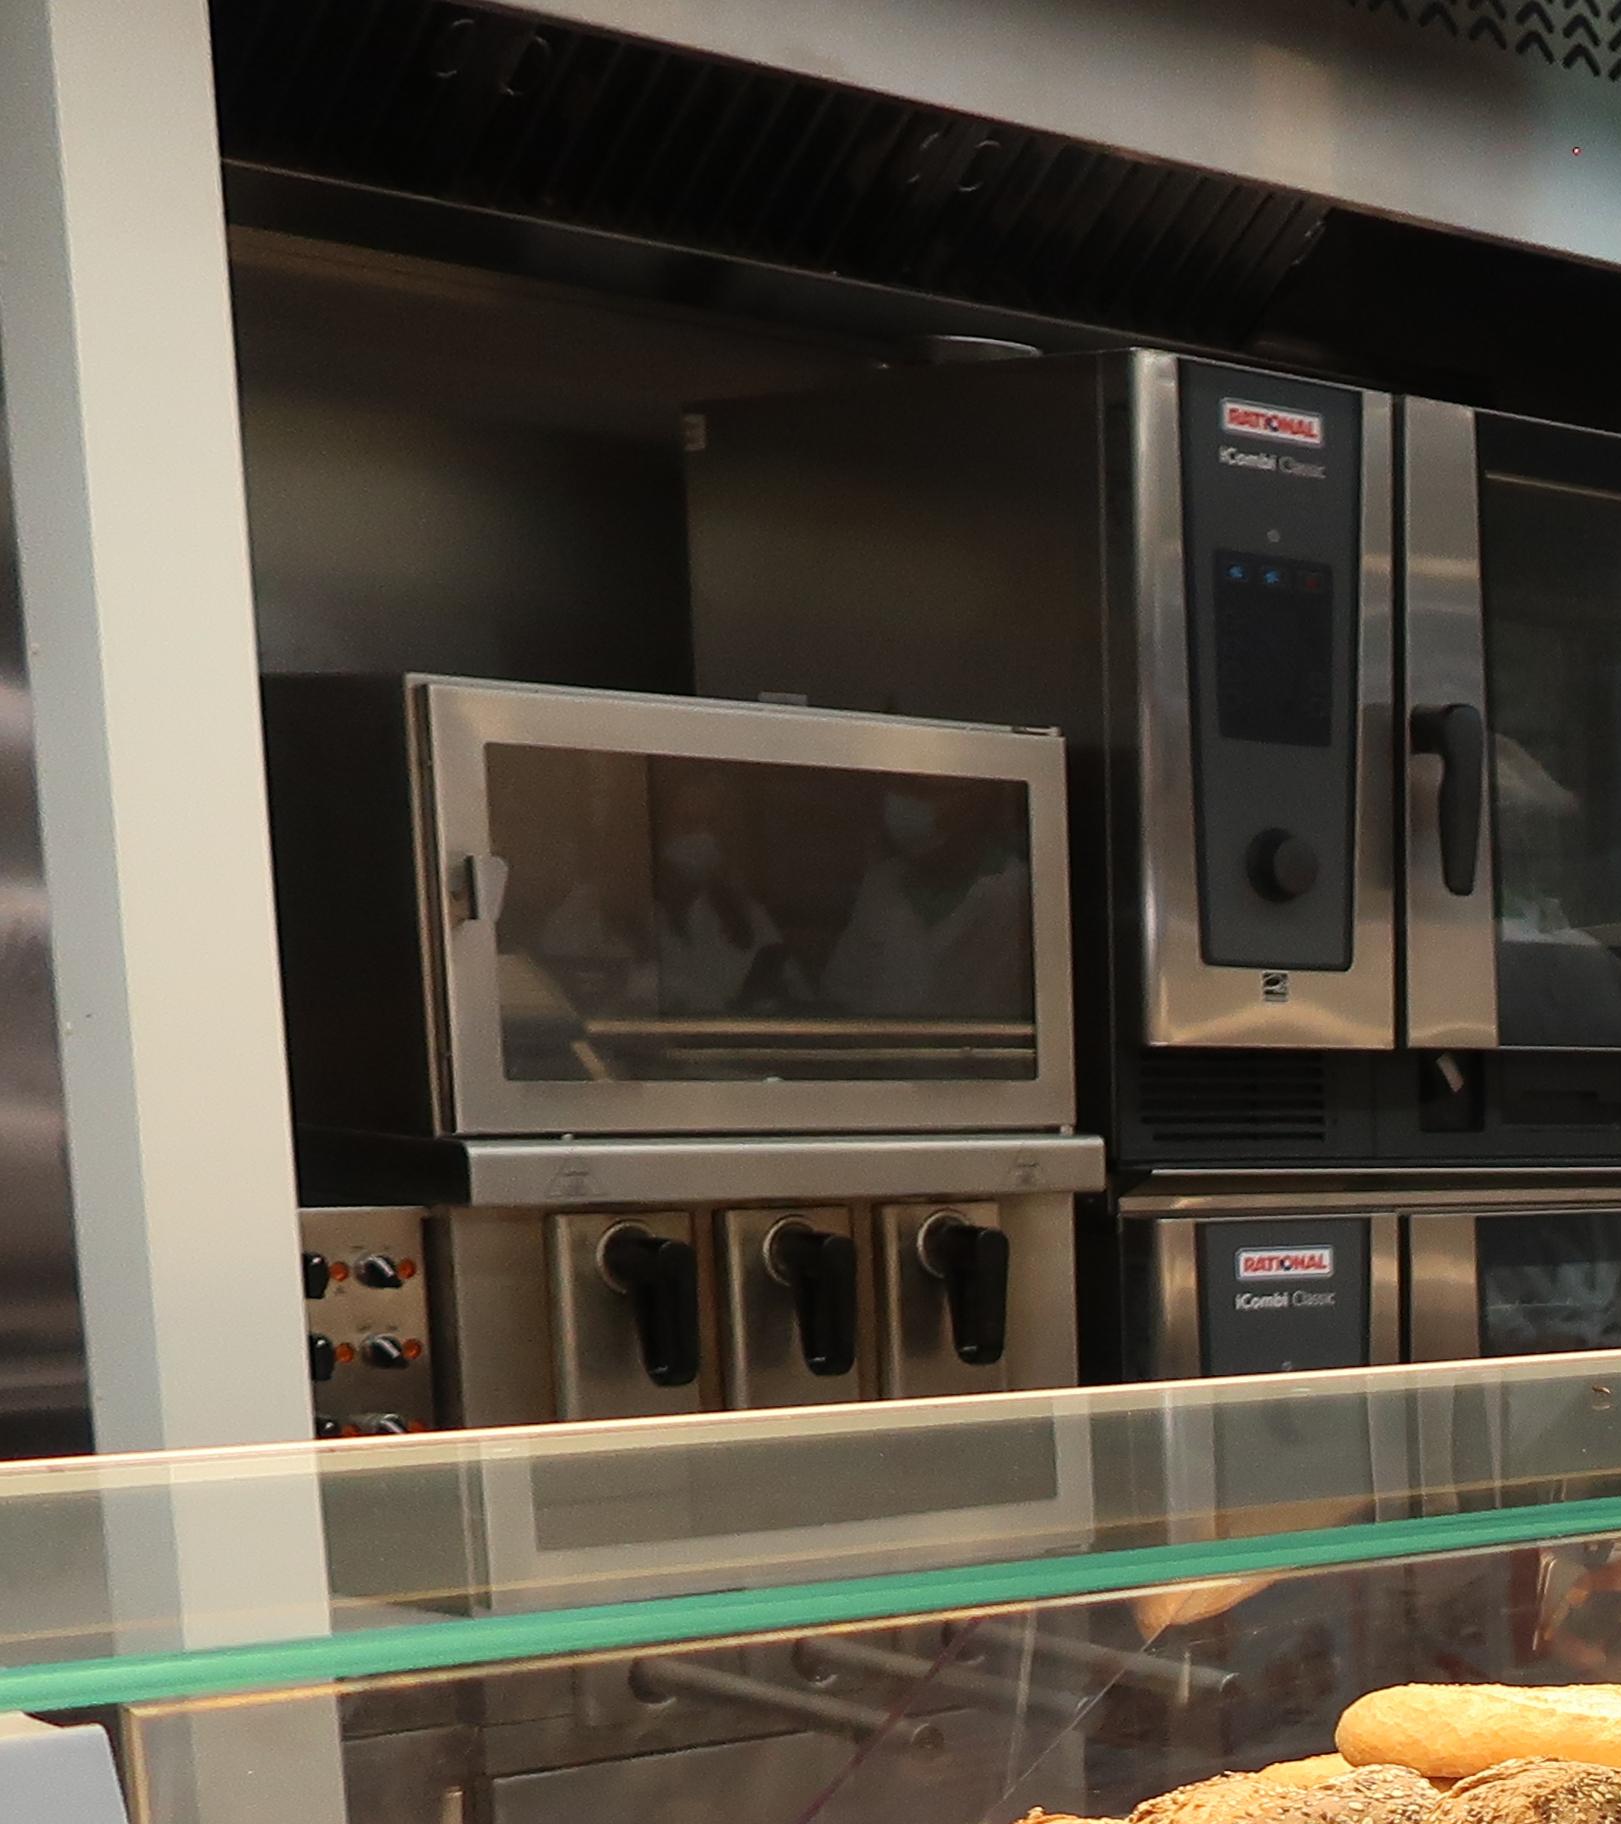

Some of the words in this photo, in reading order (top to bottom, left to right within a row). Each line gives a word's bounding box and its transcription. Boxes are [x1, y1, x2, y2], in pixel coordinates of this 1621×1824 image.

[1229, 407, 1319, 438] RATIONAL
[1244, 1253, 1328, 1272] RATIONAL
[1235, 1292, 1289, 1310] iCombi
